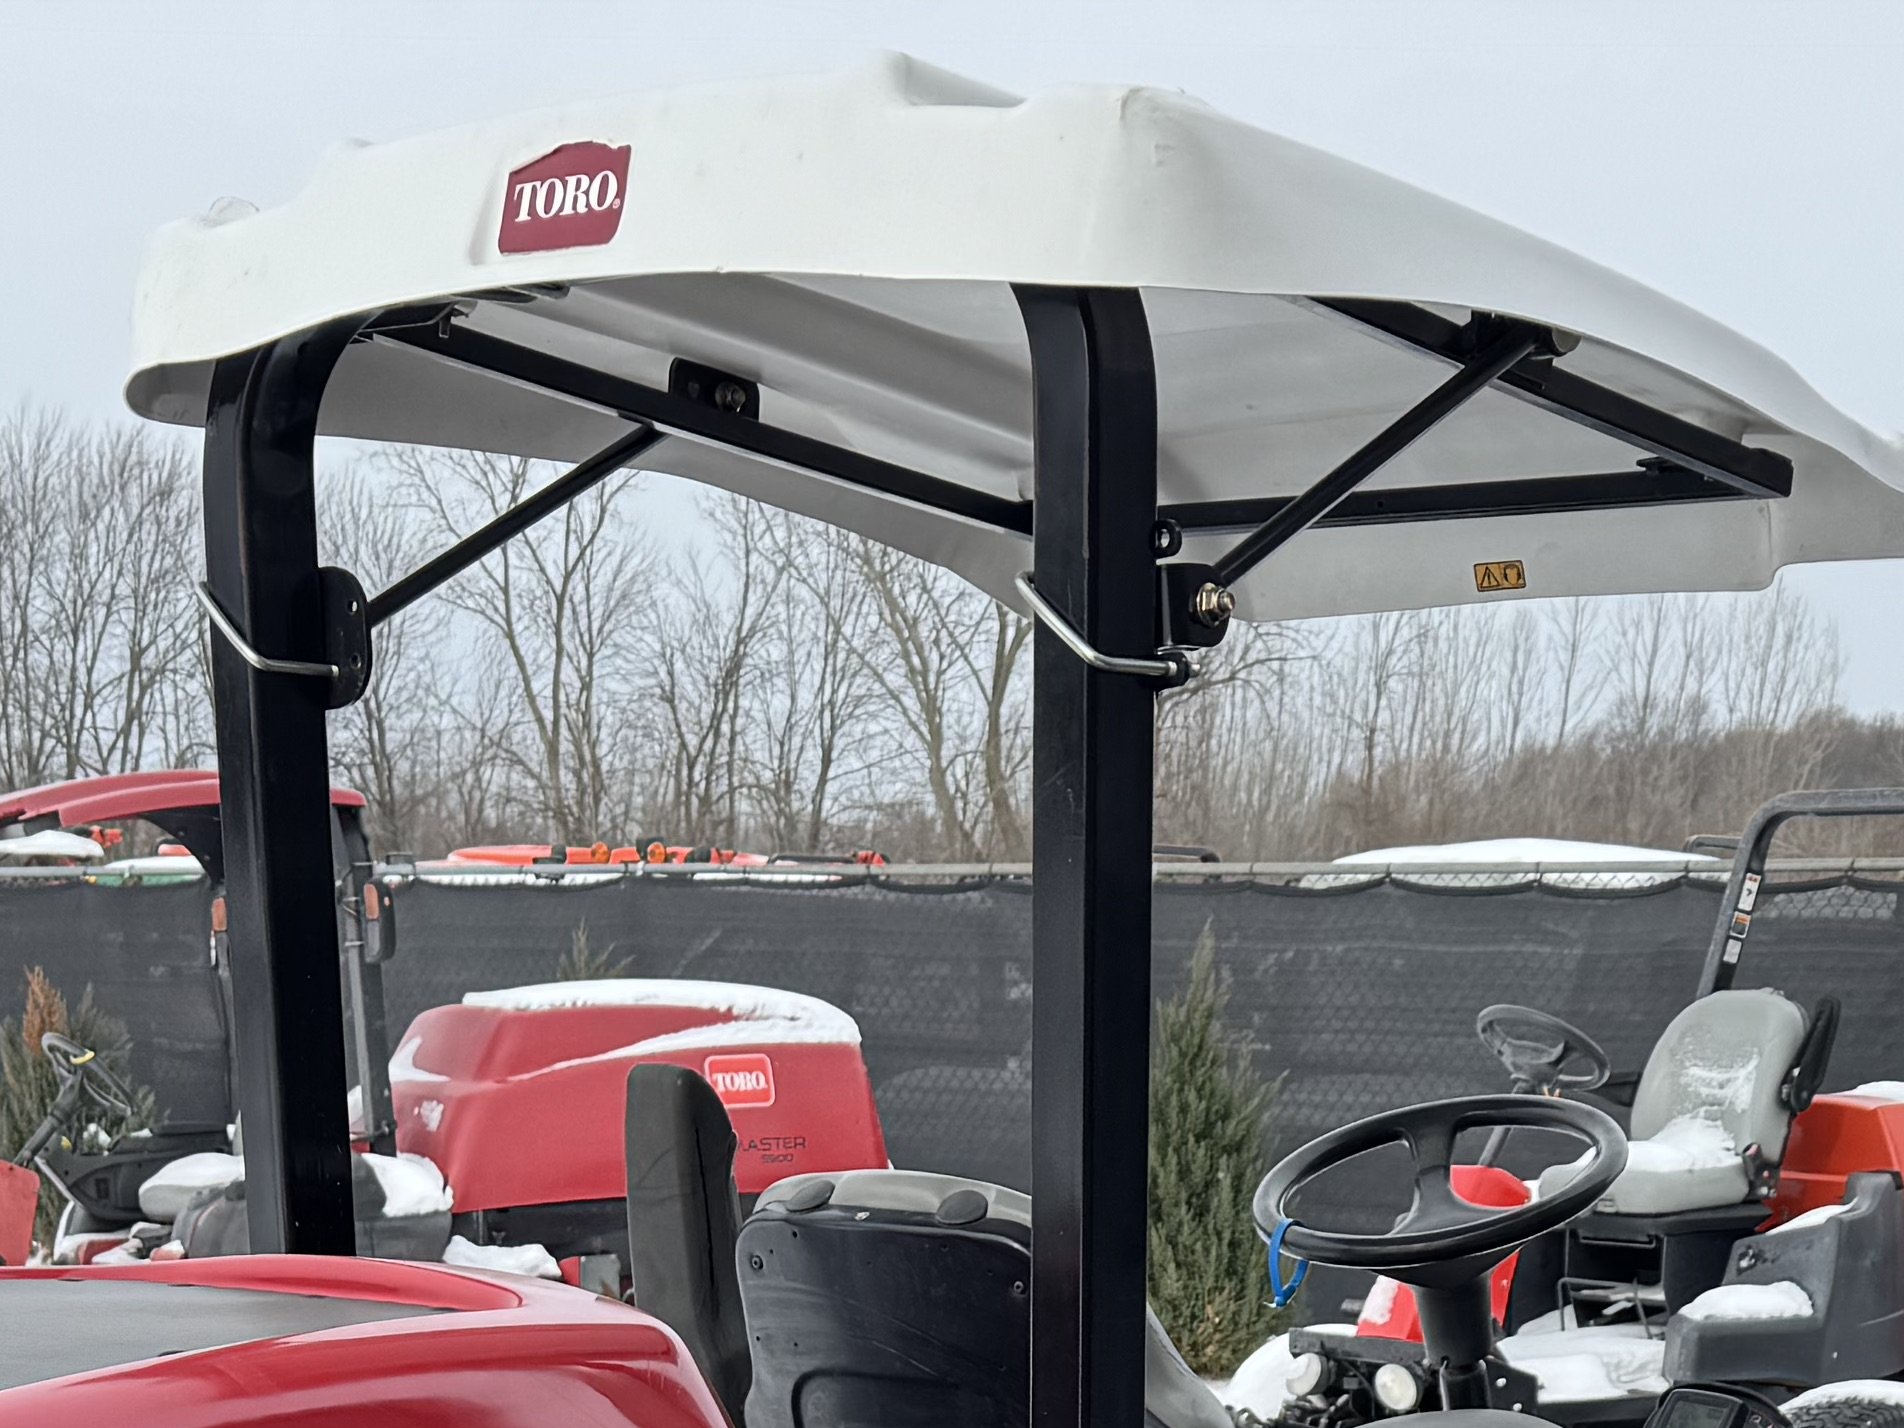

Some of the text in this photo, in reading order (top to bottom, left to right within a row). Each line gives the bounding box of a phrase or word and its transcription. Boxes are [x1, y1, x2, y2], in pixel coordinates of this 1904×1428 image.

[513, 170, 620, 222] TORO
[712, 1071, 768, 1092] TORO
[739, 1136, 807, 1152] ASTER
